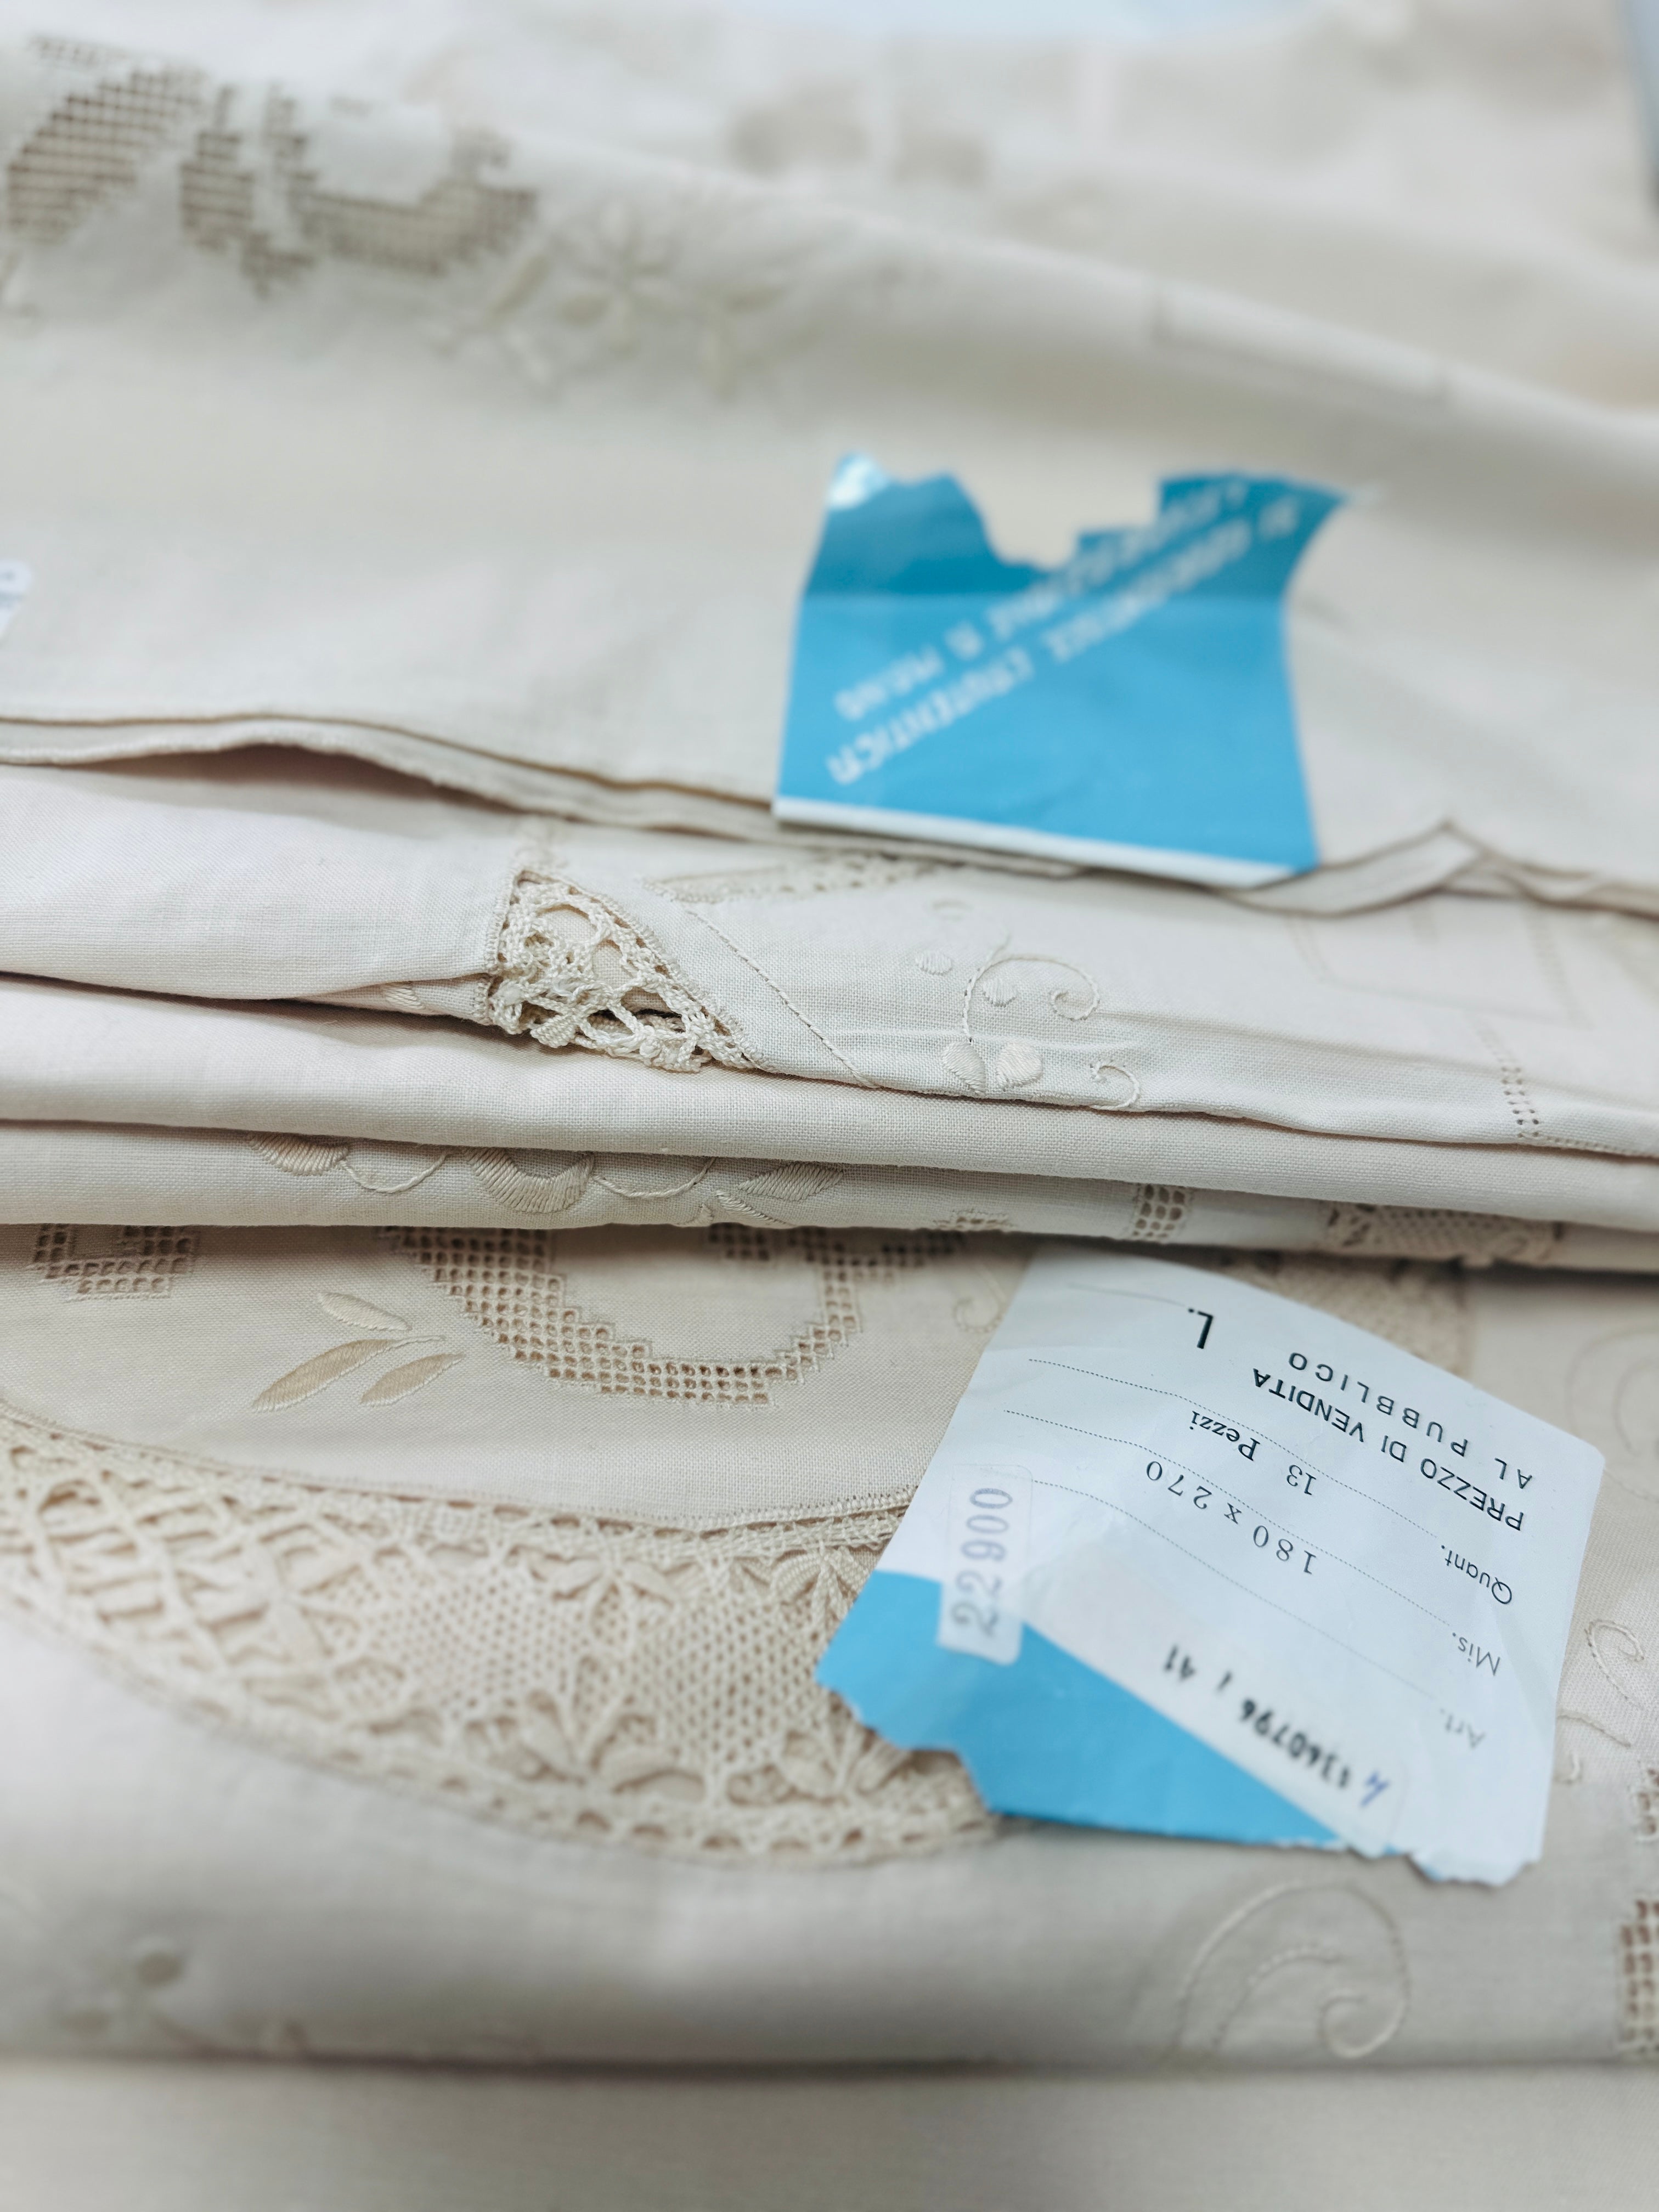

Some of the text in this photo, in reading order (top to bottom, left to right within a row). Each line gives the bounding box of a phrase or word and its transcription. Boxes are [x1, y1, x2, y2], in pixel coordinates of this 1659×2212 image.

[1188, 1308, 1214, 1350] L.
[1288, 1352, 1533, 1489] AL PUBBLICO
[1252, 1368, 1525, 1532] PREZZO DI VENDITA
[1146, 1461, 1212, 1510] 270
[1189, 1410, 1513, 1605] Quant. 13 Pezzi
[950, 1487, 1013, 1639] 22900
[1252, 1525, 1317, 1576] 180
[1452, 1632, 1500, 1677] Mis.
[1440, 1708, 1486, 1750] Art.
